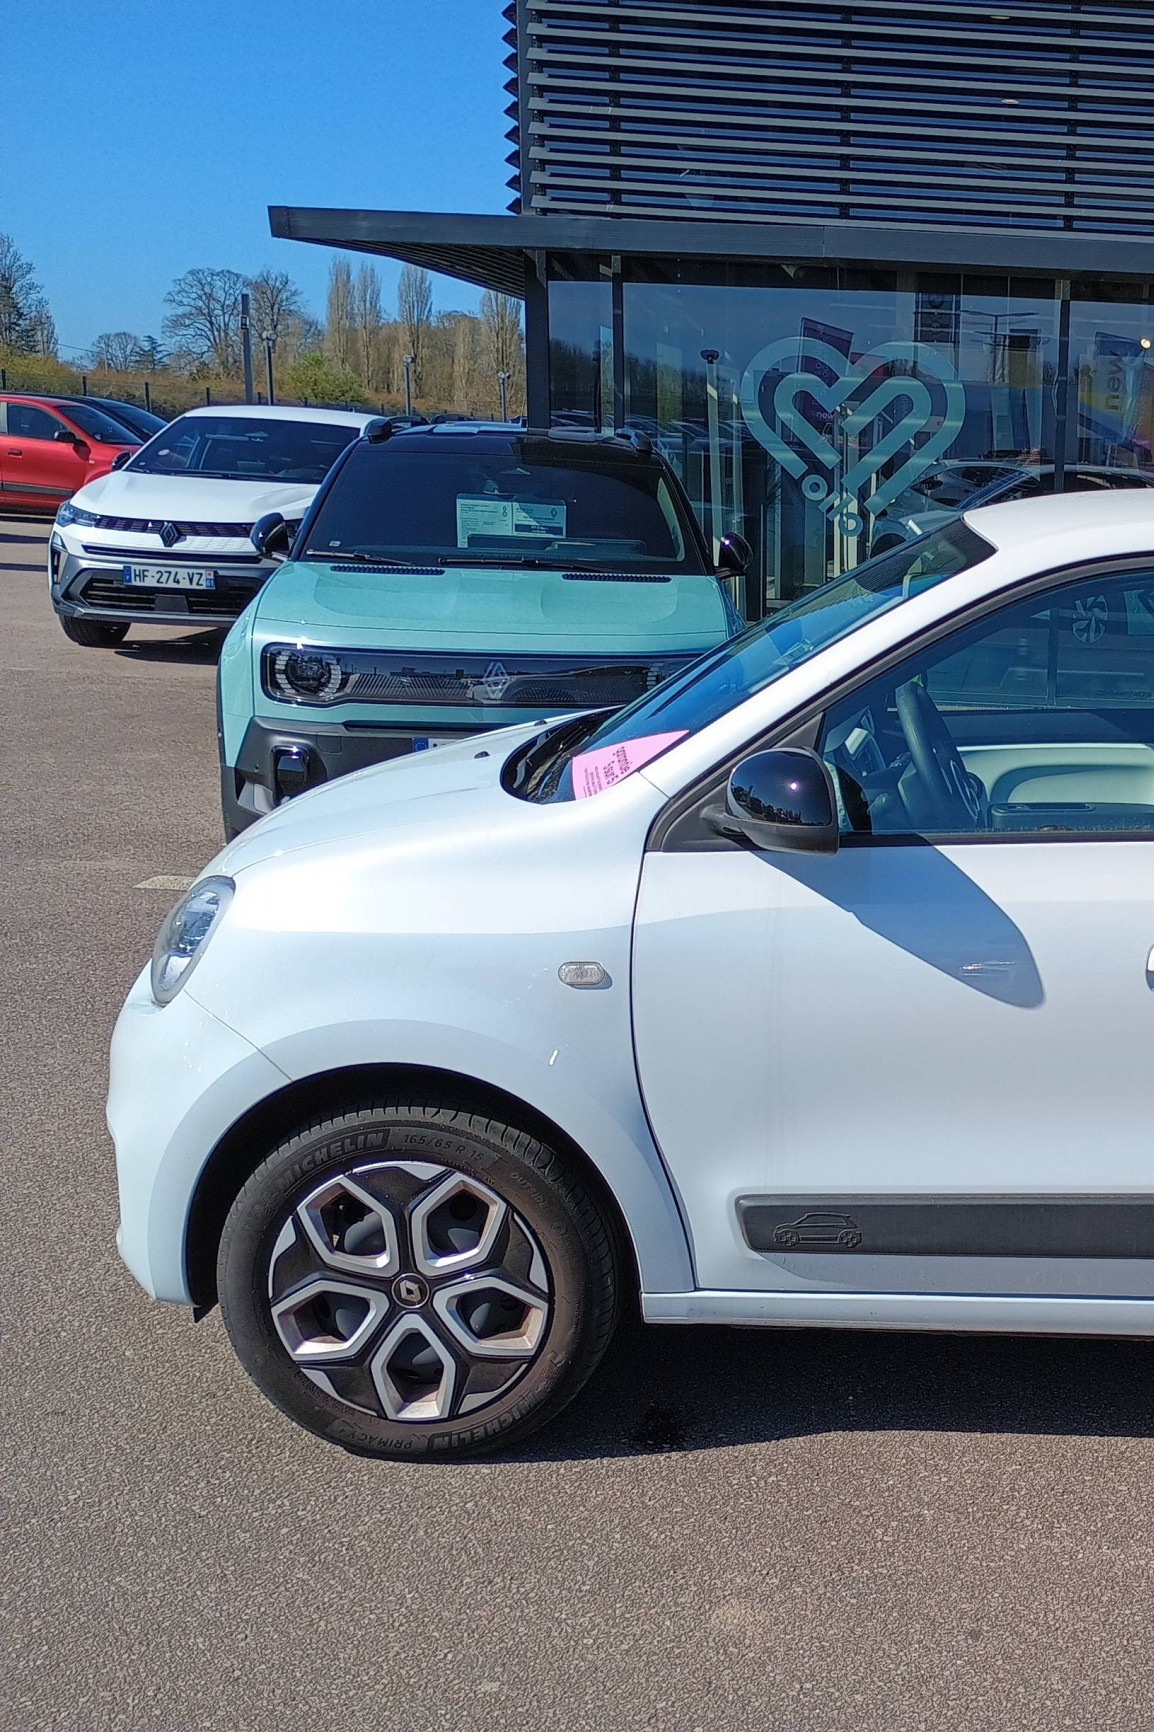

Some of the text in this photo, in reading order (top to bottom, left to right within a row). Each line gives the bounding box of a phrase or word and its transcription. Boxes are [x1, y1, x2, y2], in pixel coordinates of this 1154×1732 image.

[134, 569, 203, 586] HF-274-VZ
[280, 1131, 384, 1187] MICHELIN
[404, 1133, 485, 1163] 165/65 R 15
[432, 1393, 537, 1450] MICHELIN
[348, 1429, 414, 1450] PRIMACY
